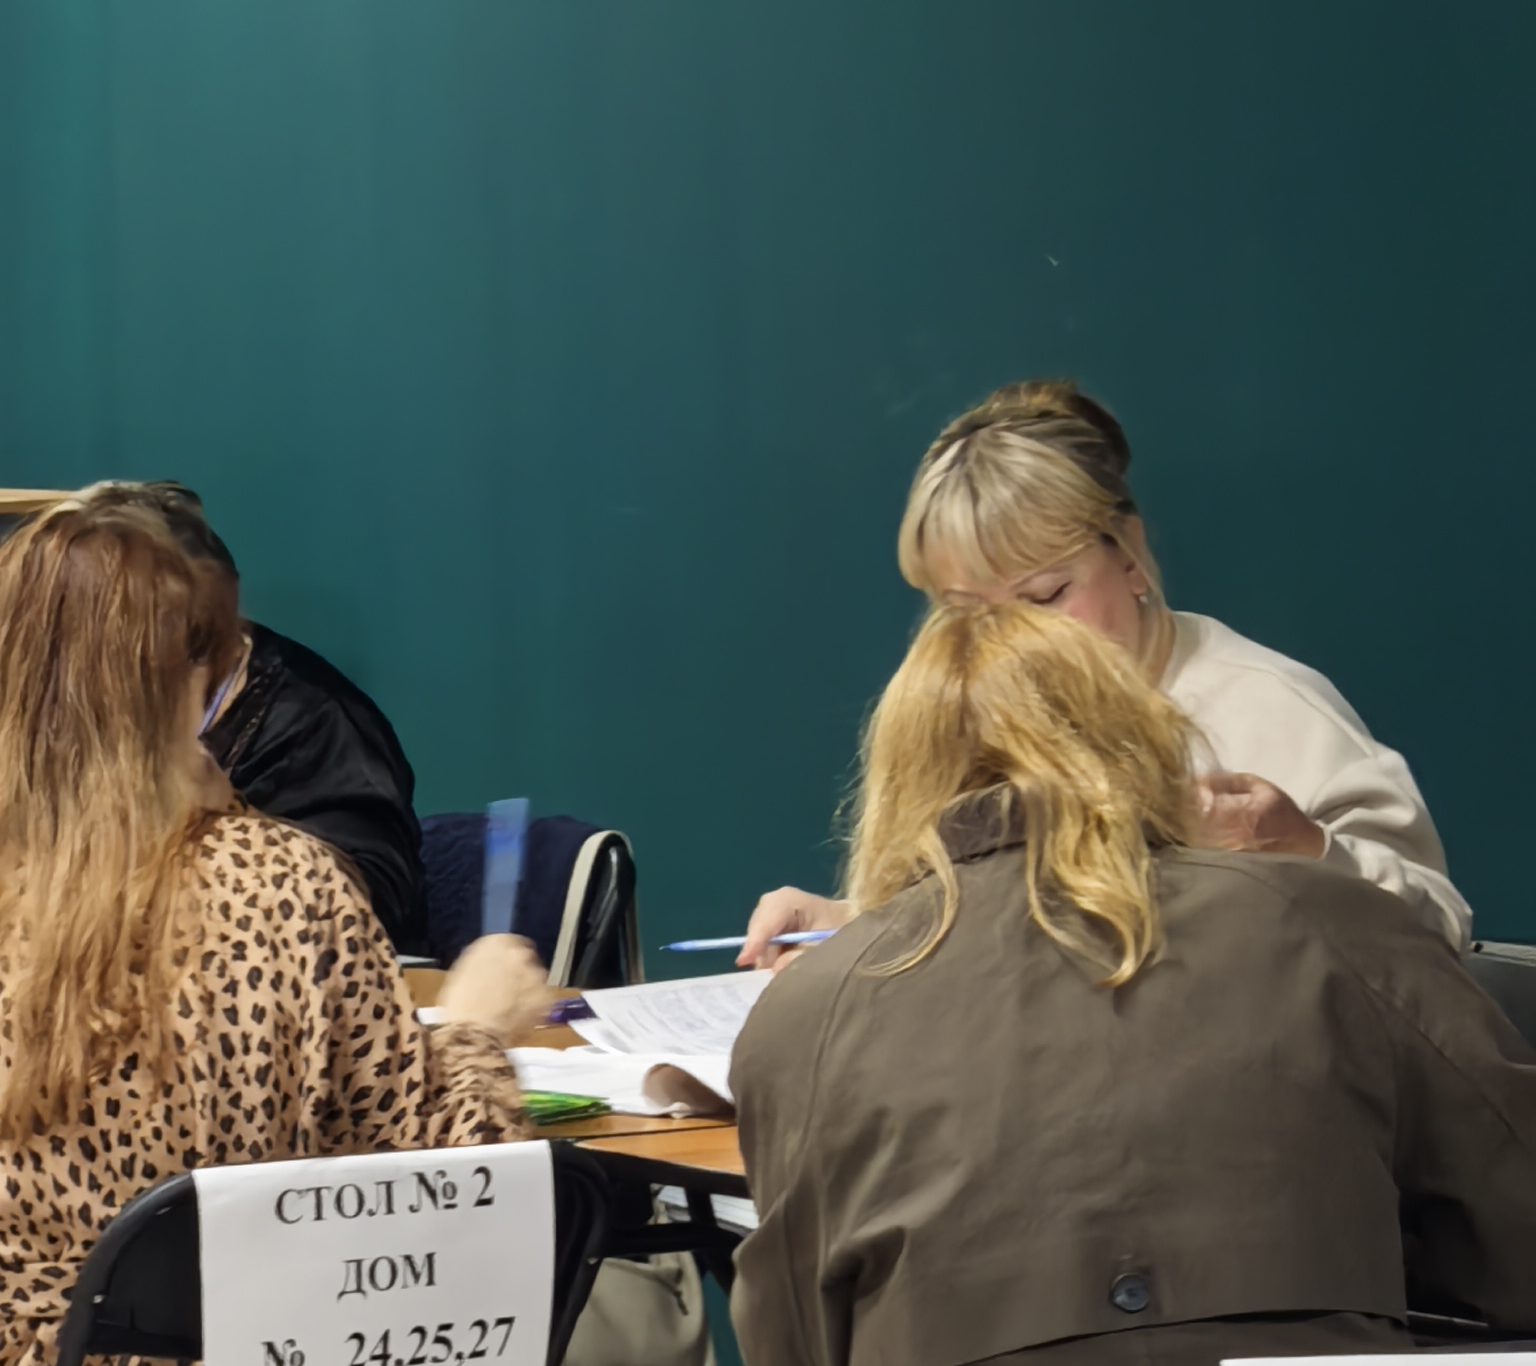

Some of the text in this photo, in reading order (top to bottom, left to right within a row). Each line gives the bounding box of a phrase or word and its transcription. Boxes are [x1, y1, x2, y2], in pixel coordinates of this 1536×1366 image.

[274, 1165, 496, 1225] СТОЛ № 2
[336, 1251, 438, 1303] ДОМ
